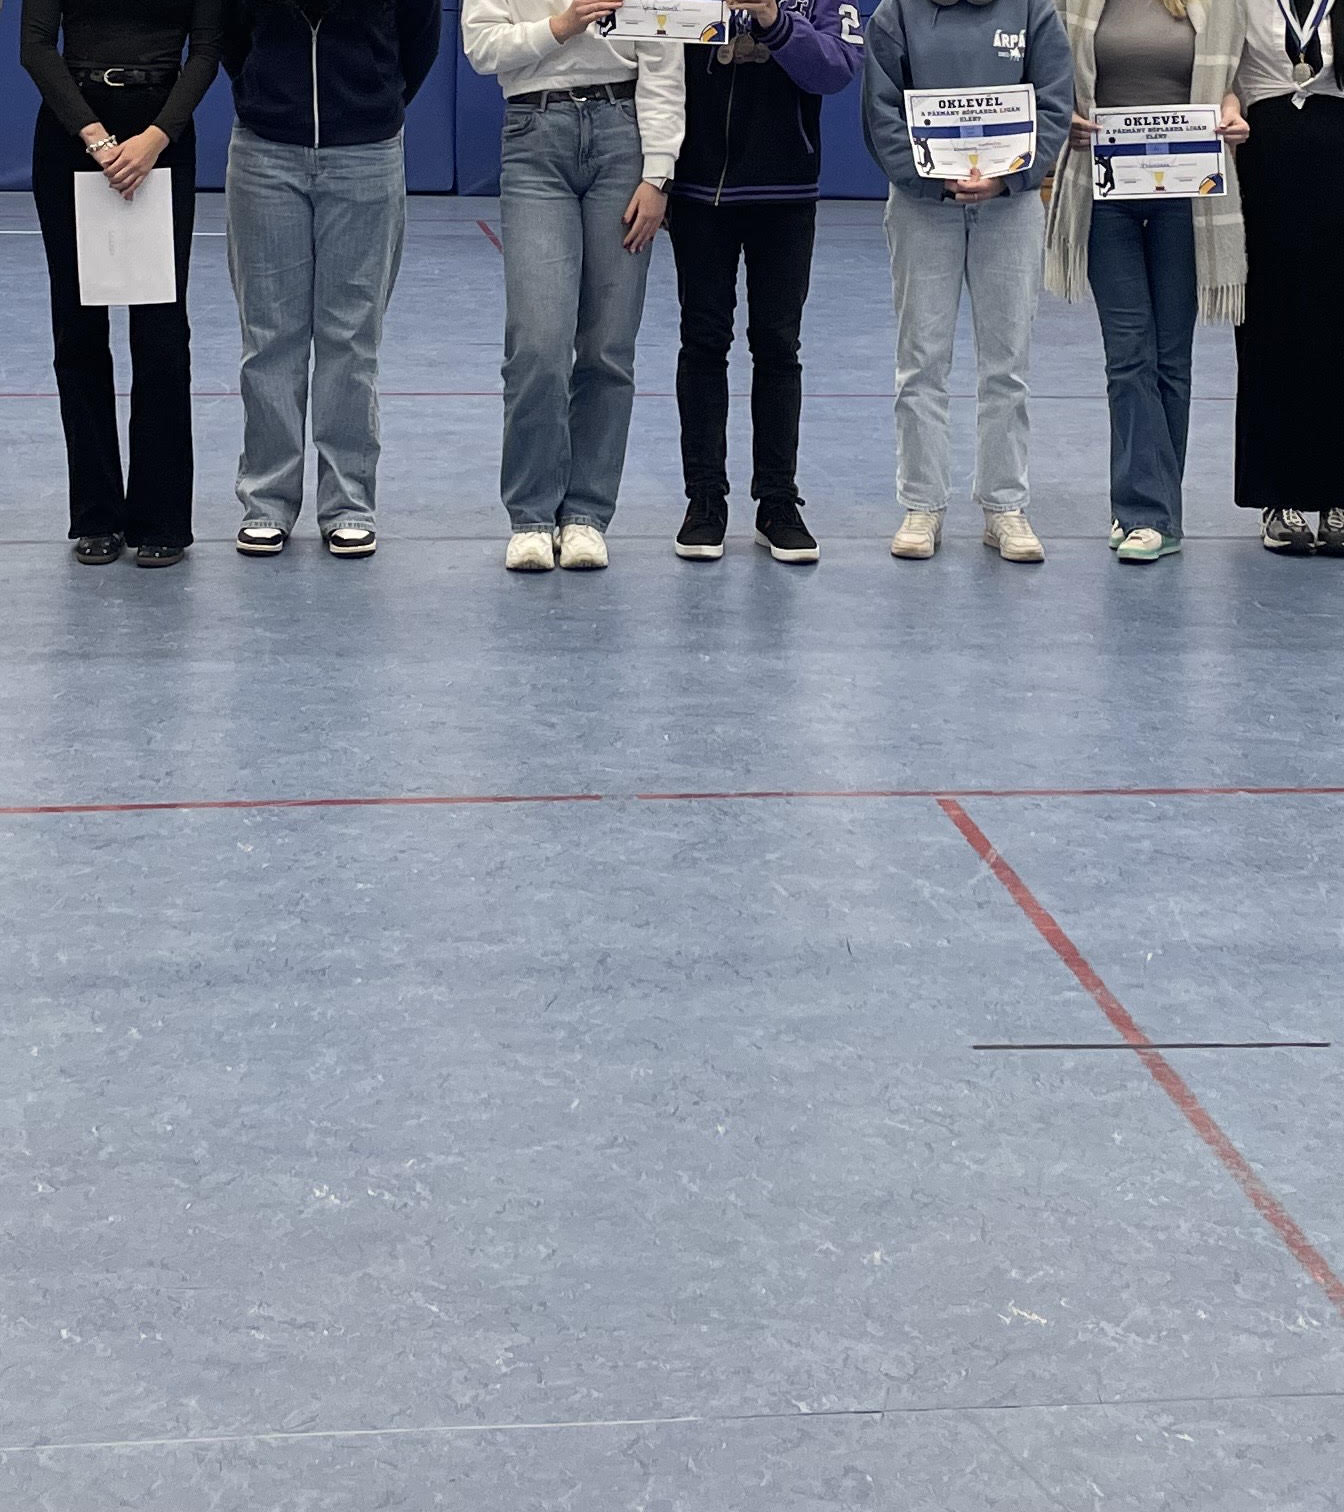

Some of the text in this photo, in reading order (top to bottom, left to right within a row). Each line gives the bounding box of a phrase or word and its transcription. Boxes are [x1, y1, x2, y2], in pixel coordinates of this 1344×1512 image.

[838, 3, 864, 45] 2
[938, 94, 1003, 109] OKLEVÉL
[1124, 112, 1189, 127] OKLEVÉL
